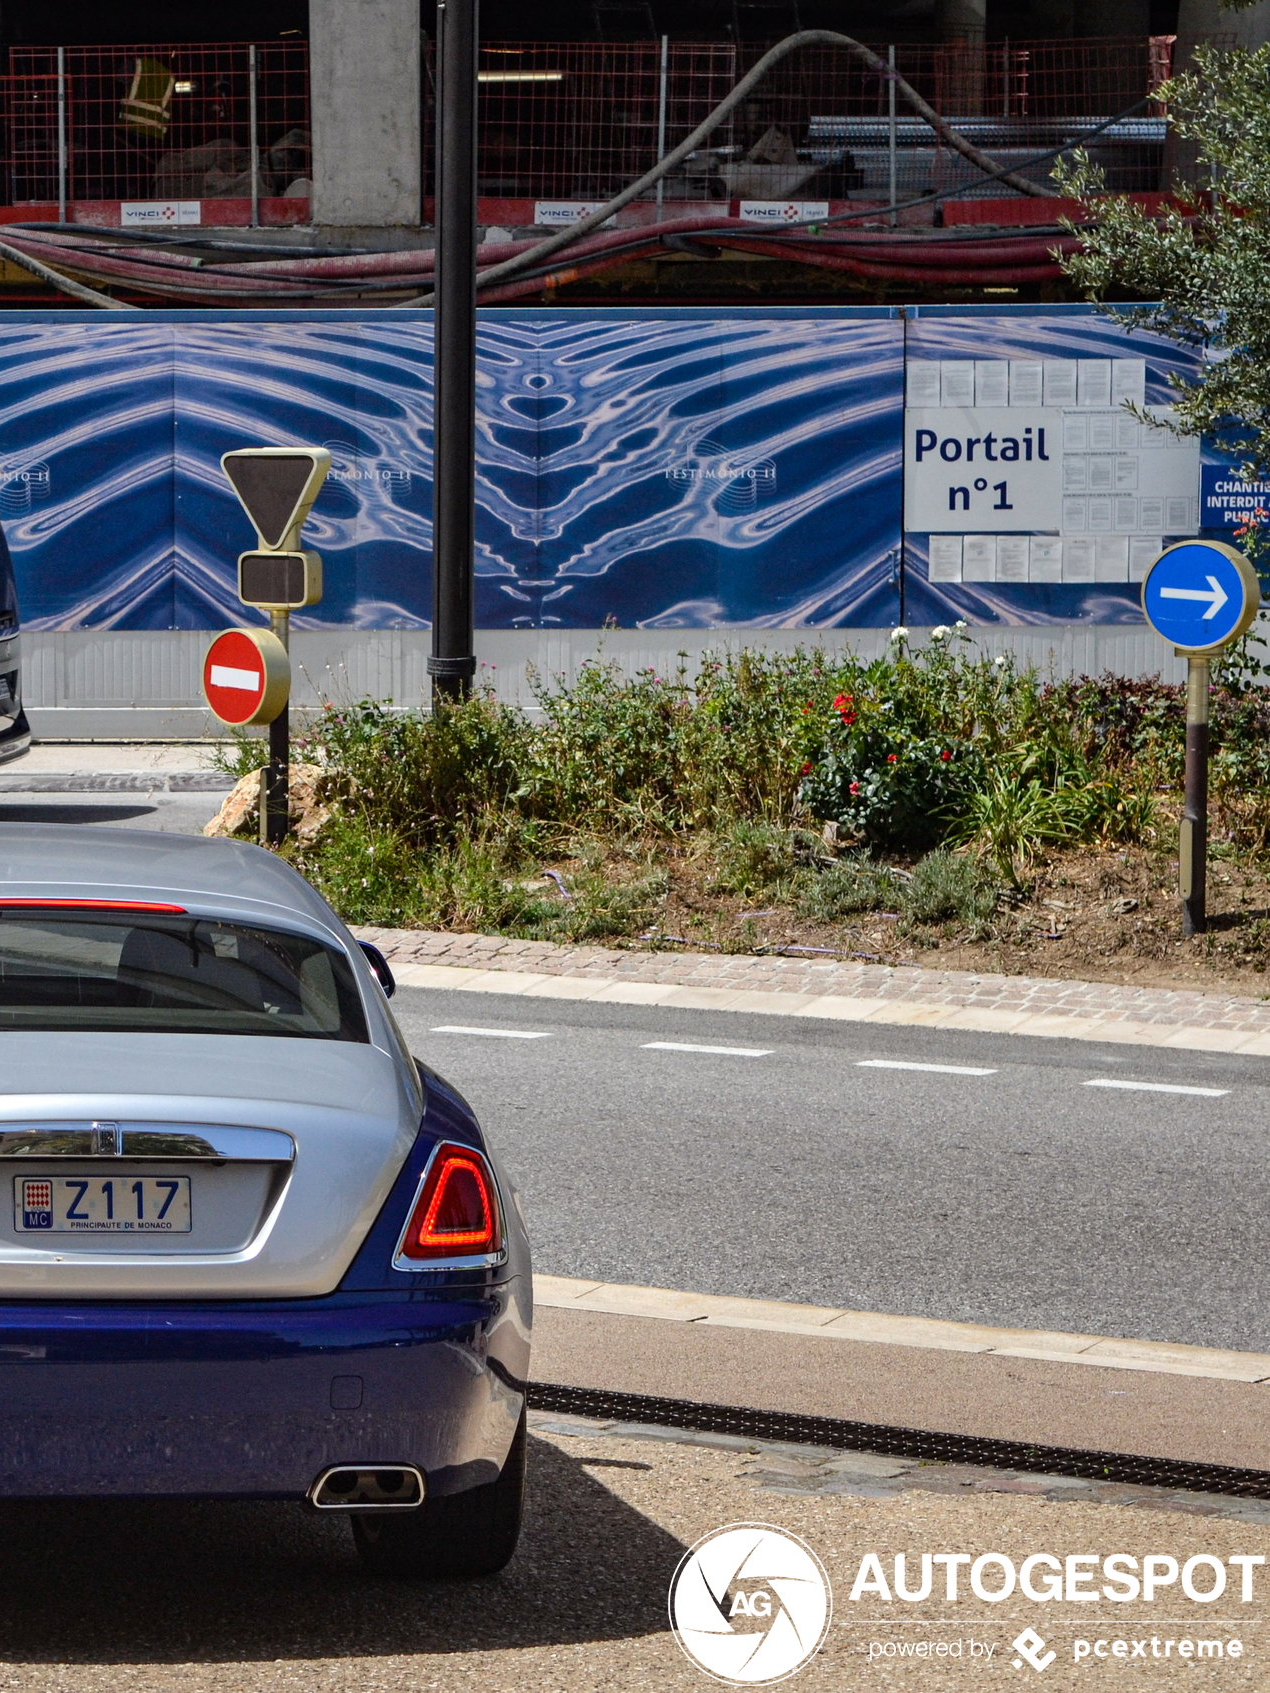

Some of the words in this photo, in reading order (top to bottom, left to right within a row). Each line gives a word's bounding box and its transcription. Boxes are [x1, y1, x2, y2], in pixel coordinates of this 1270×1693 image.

[915, 427, 1050, 462] Portail
[38, 472, 49, 482] II
[326, 470, 391, 480] TIMONIO
[399, 470, 411, 480] II
[664, 469, 756, 479] TESTIMONIO
[764, 468, 776, 479] II
[1215, 481, 1270, 493] CHANTIE
[948, 477, 1014, 510] n°1
[1207, 496, 1266, 508] INTERDIT
[65, 1181, 179, 1220] Z117
[29, 1213, 48, 1226] MC
